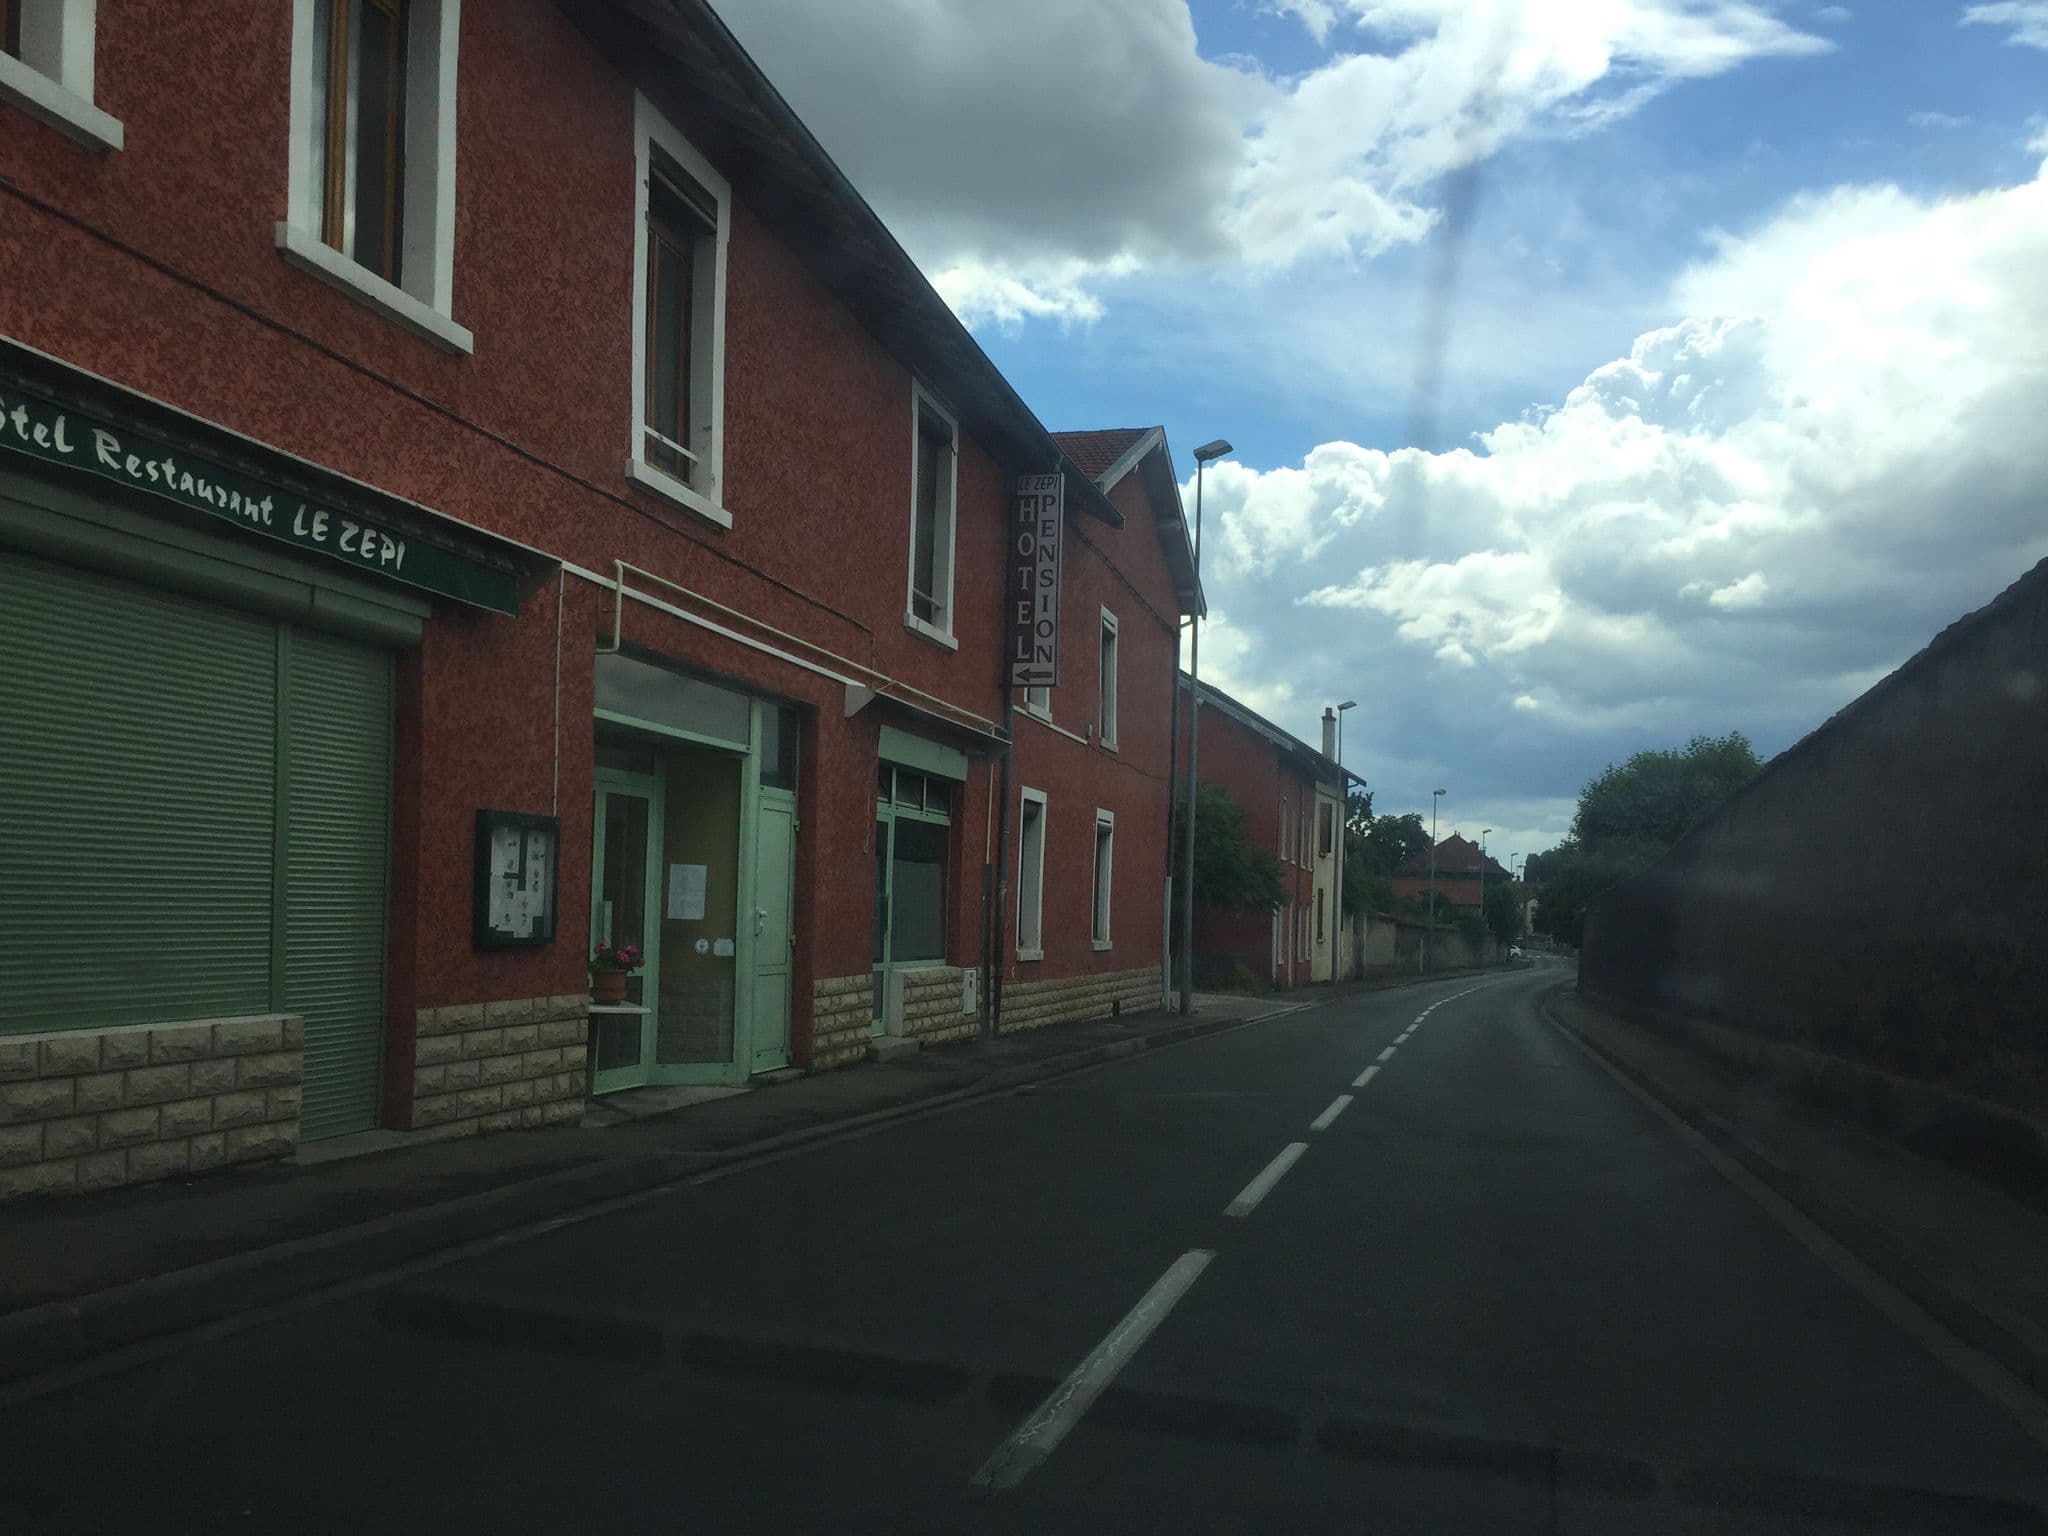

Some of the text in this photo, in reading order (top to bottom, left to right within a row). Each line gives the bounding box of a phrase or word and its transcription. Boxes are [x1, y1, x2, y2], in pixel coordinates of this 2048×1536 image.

[92, 428, 273, 526] Restaurant
[293, 505, 329, 542] LE
[340, 520, 406, 570] ZEPI
[1018, 476, 1059, 491] LE ZEPI
[1017, 498, 1035, 660] HOTEL
[1036, 494, 1057, 664] PENSION
